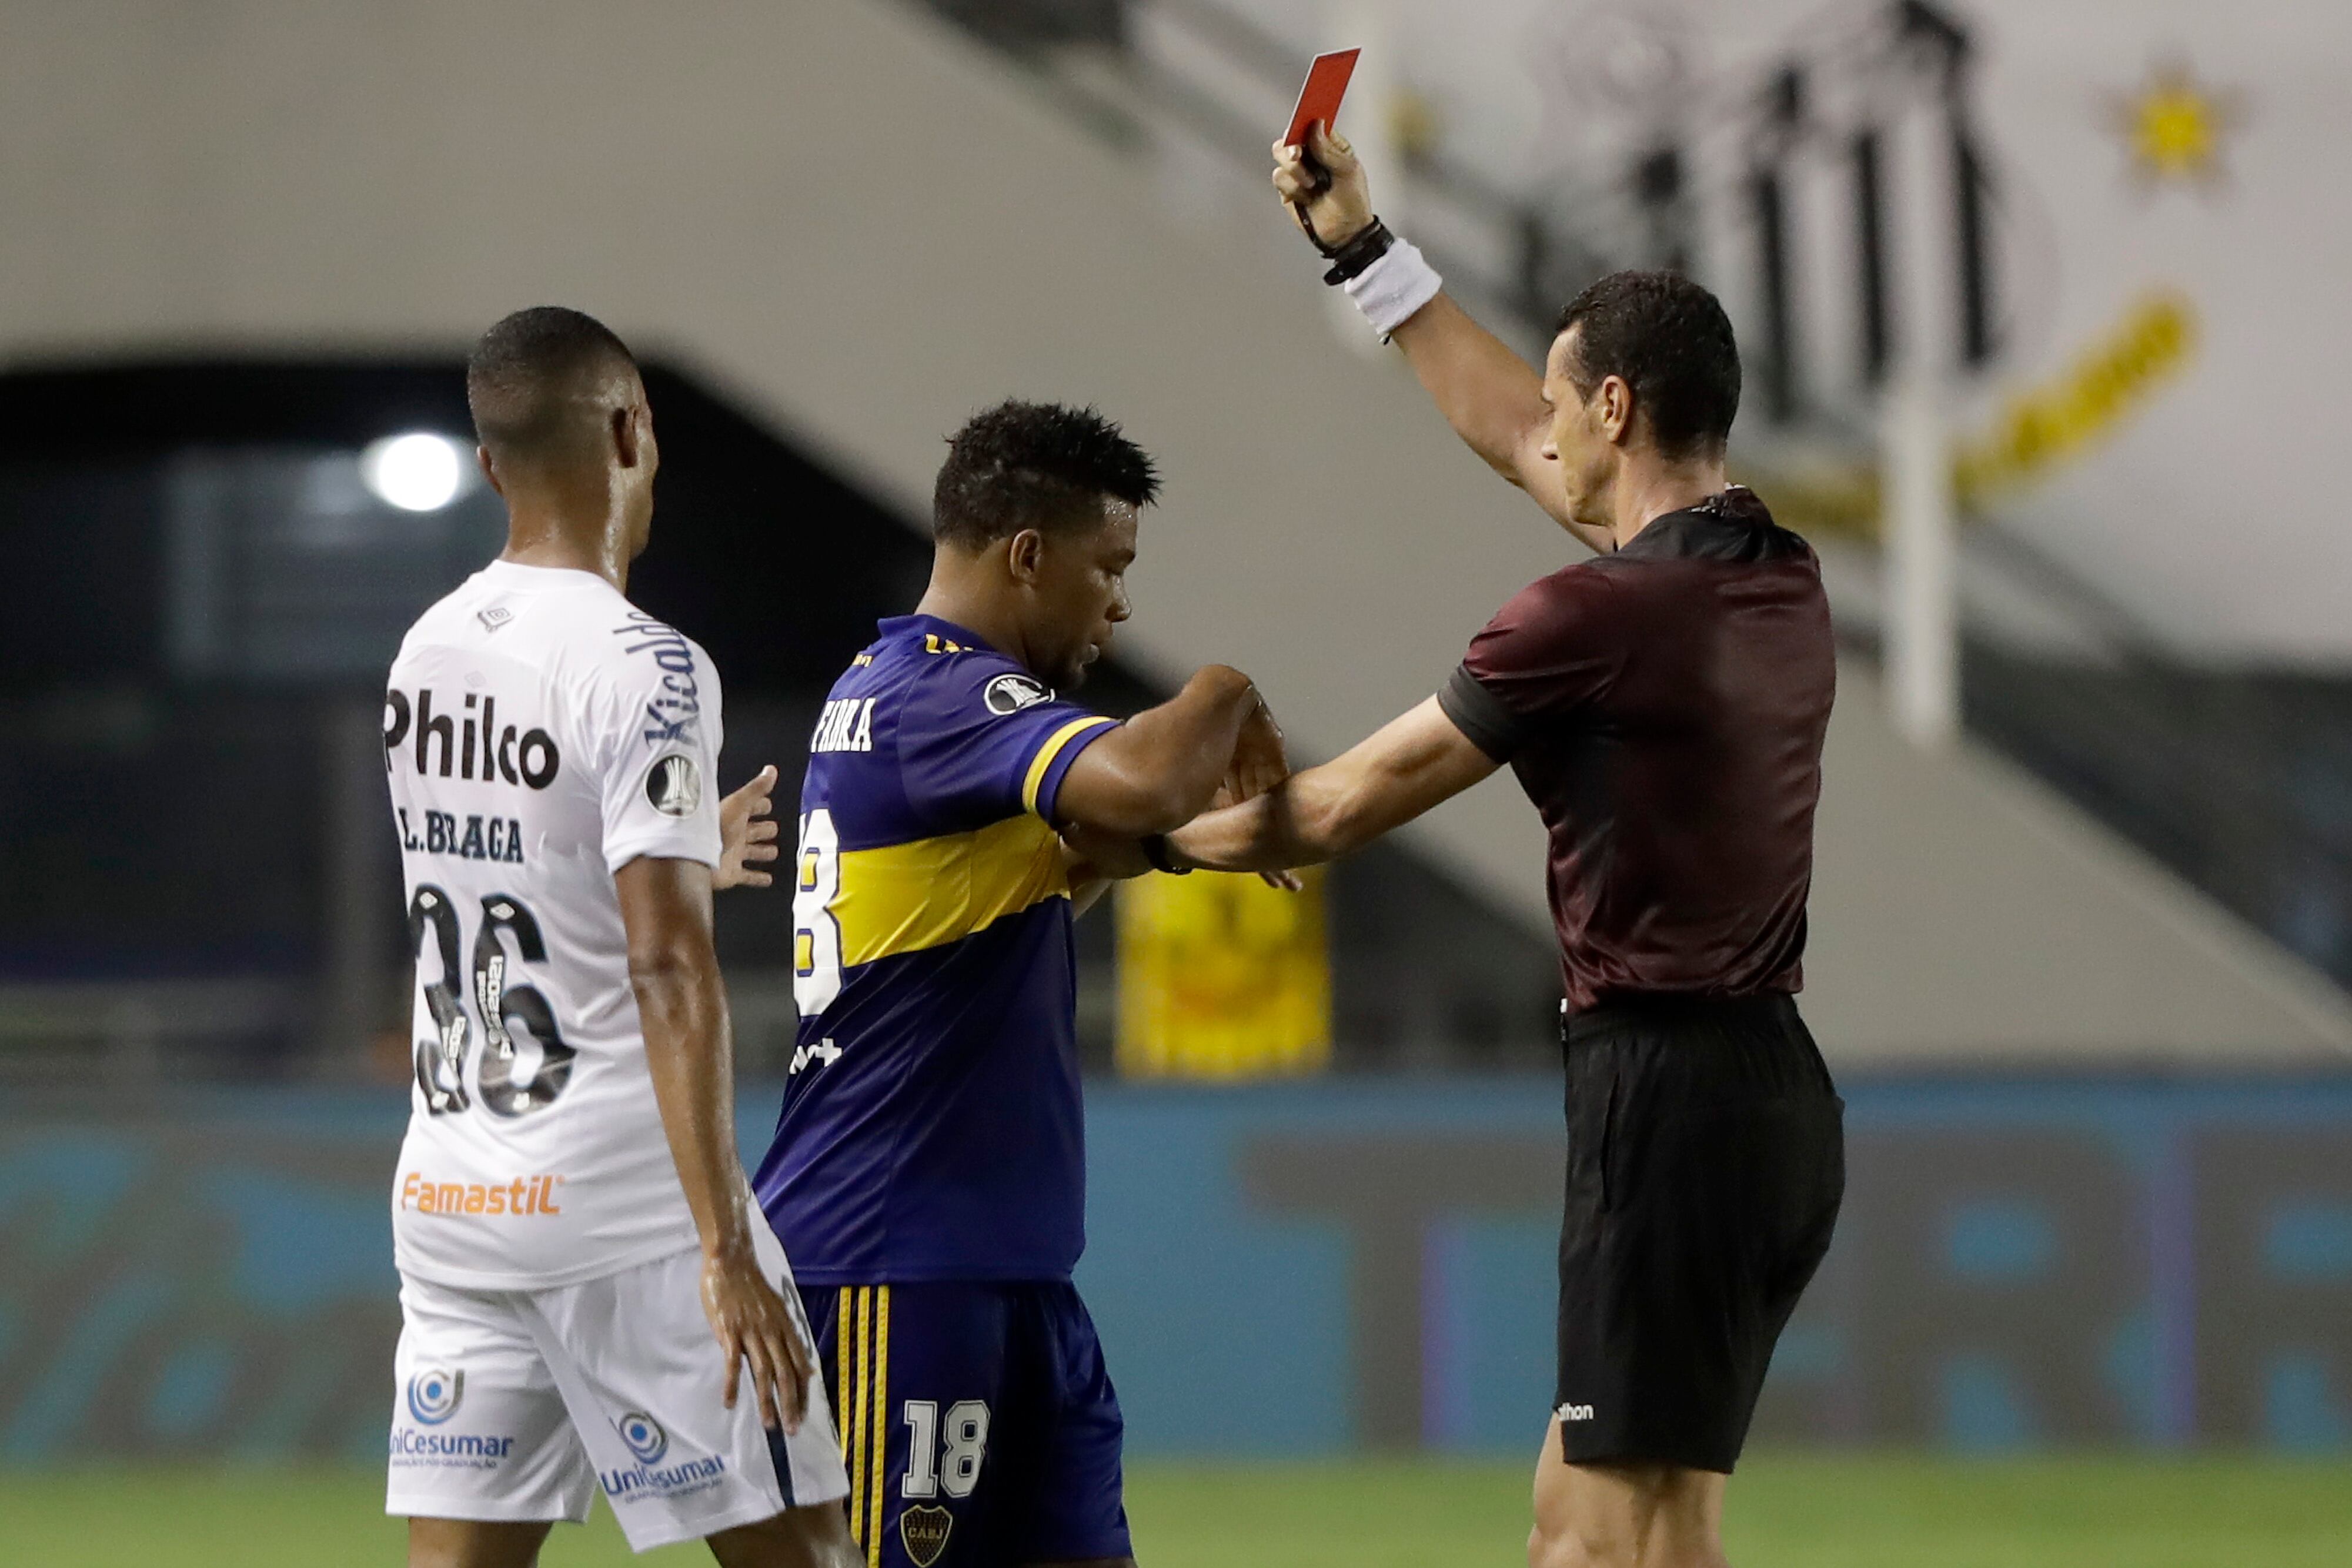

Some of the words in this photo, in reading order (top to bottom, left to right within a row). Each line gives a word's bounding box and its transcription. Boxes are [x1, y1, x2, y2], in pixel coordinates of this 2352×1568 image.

[383, 688, 560, 790] Philco
[397, 807, 524, 863] L.BRAGA
[902, 1400, 991, 1498] 18
